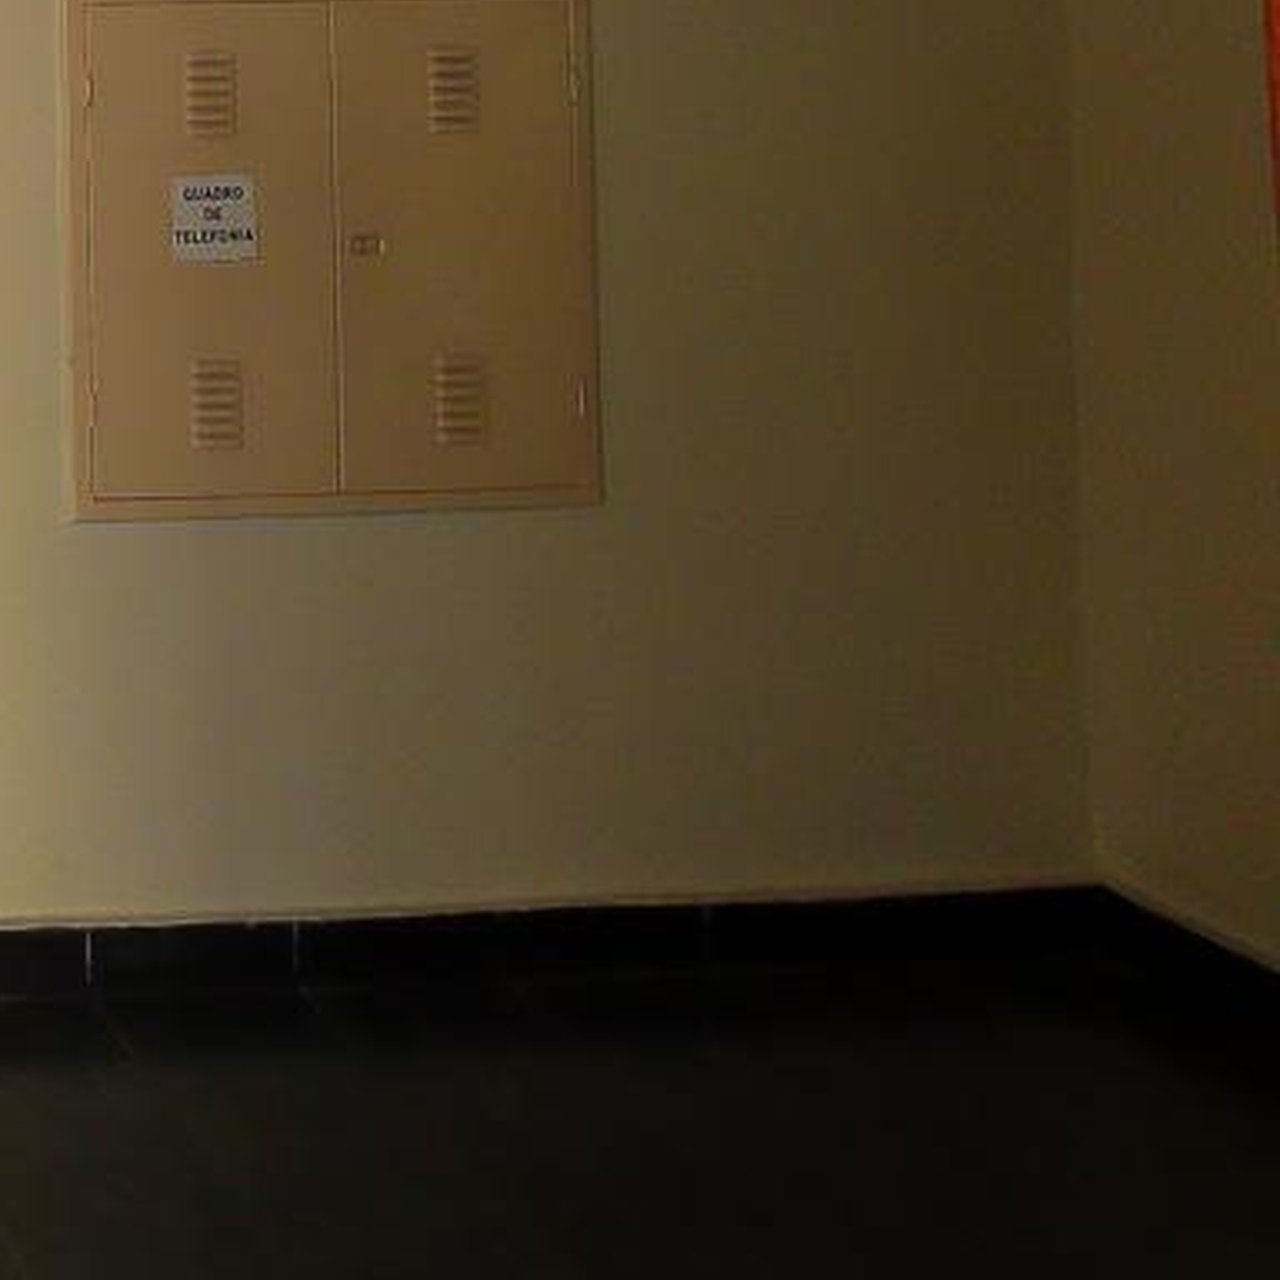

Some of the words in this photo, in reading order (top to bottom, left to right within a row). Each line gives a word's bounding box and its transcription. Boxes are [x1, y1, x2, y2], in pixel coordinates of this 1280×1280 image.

[182, 185, 245, 201] QUADRO
[203, 205, 222, 221] DE
[175, 228, 254, 245] TELEFONIA
